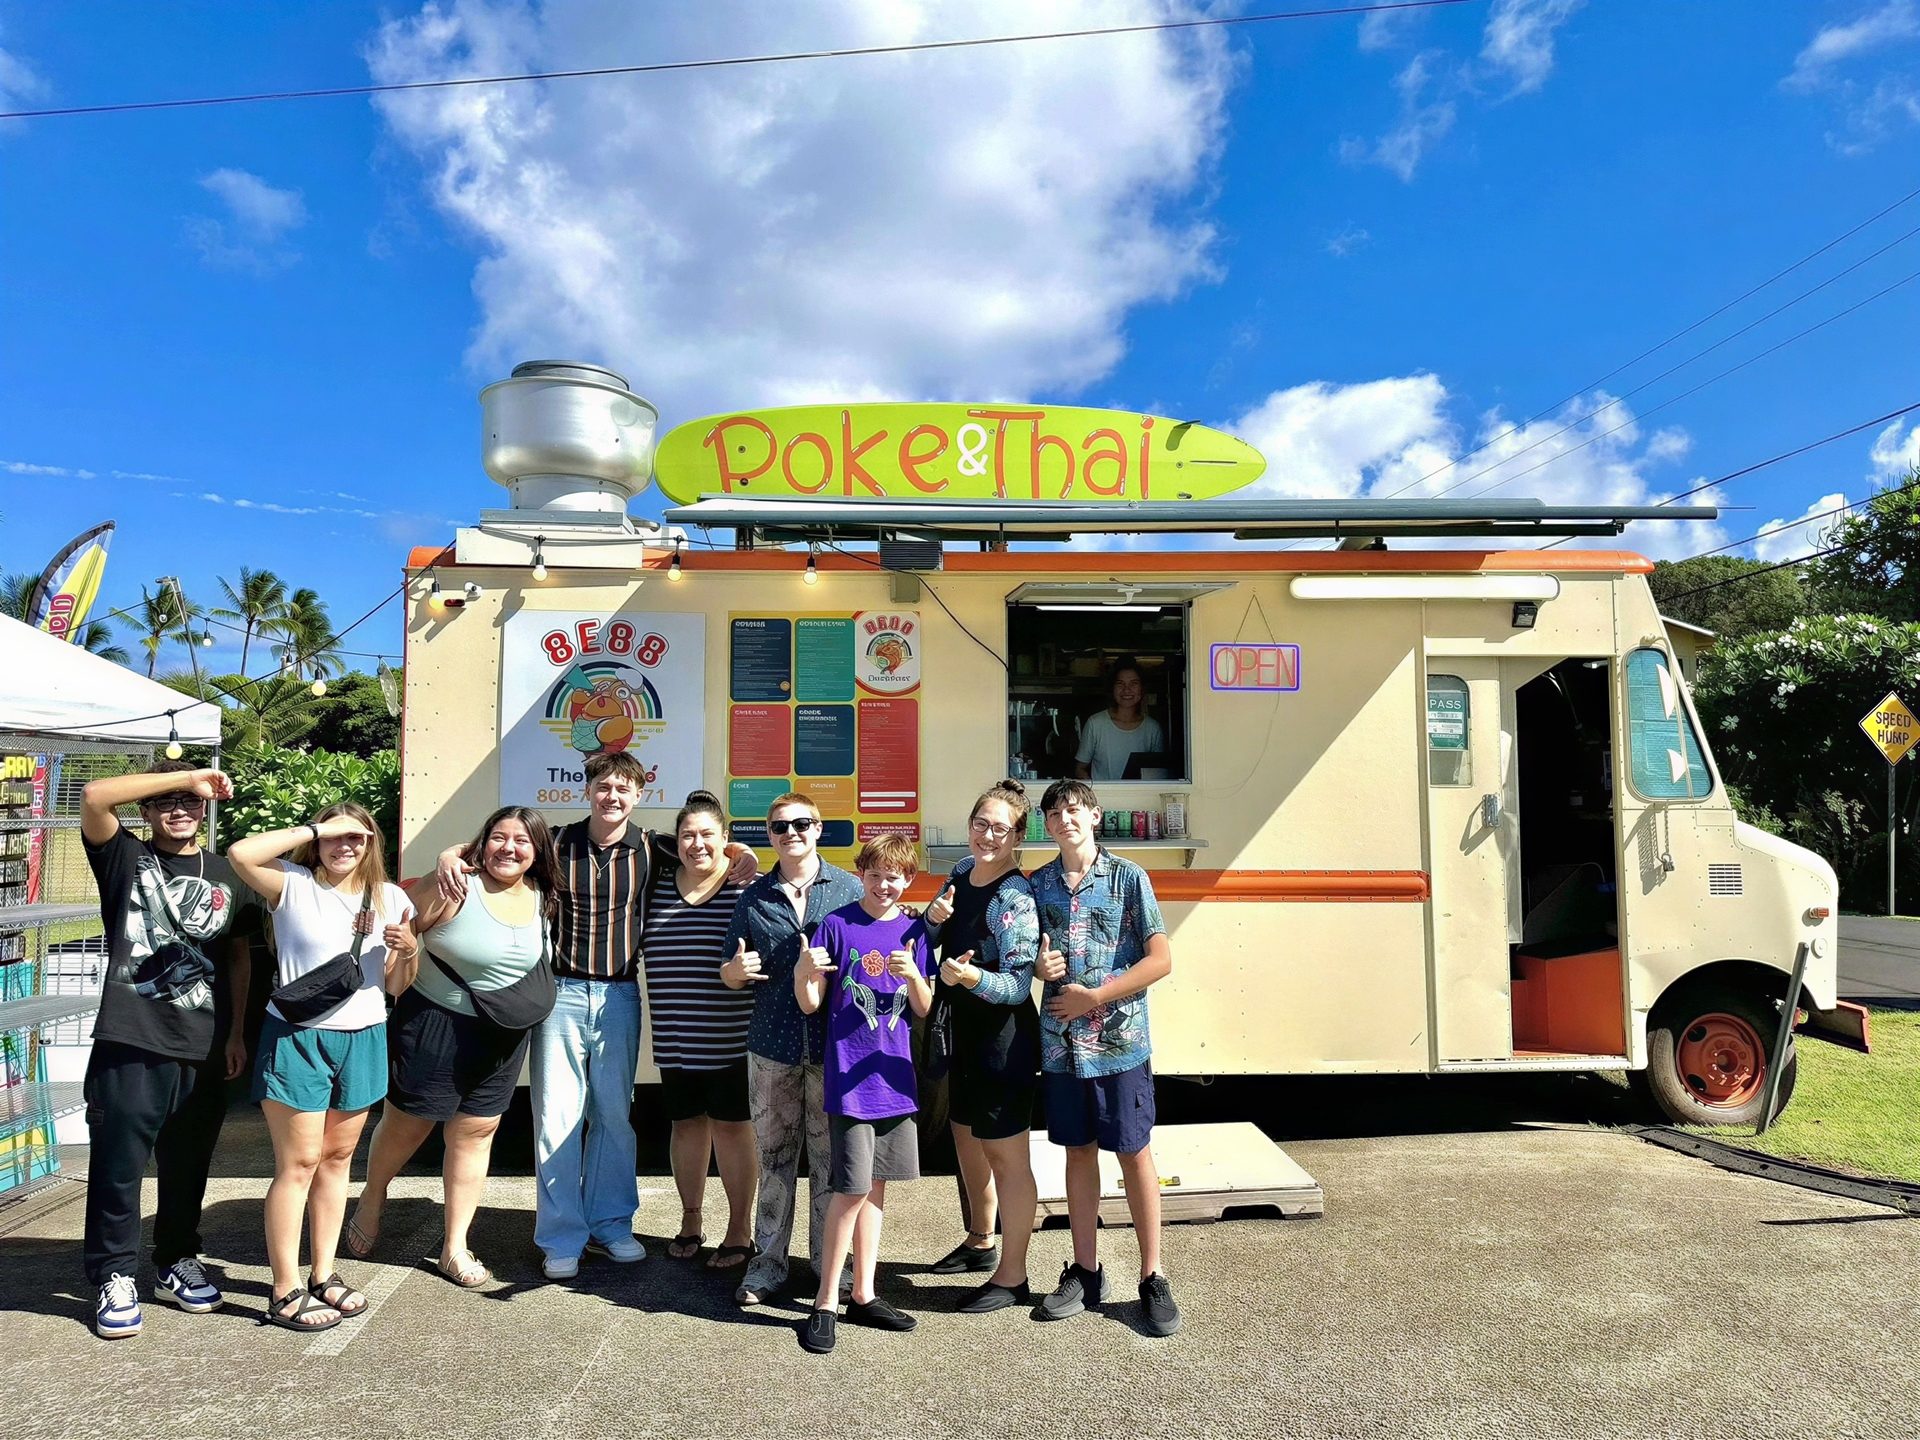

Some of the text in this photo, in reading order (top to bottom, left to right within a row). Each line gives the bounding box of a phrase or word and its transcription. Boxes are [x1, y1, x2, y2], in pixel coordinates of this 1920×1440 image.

[702, 408, 1155, 499] Poke & Thai
[541, 618, 669, 668] 8E88
[1214, 647, 1296, 687] OPEN
[1429, 700, 1462, 710] PASS
[1875, 711, 1911, 728] SPEED
[1877, 729, 1910, 746] HUMP
